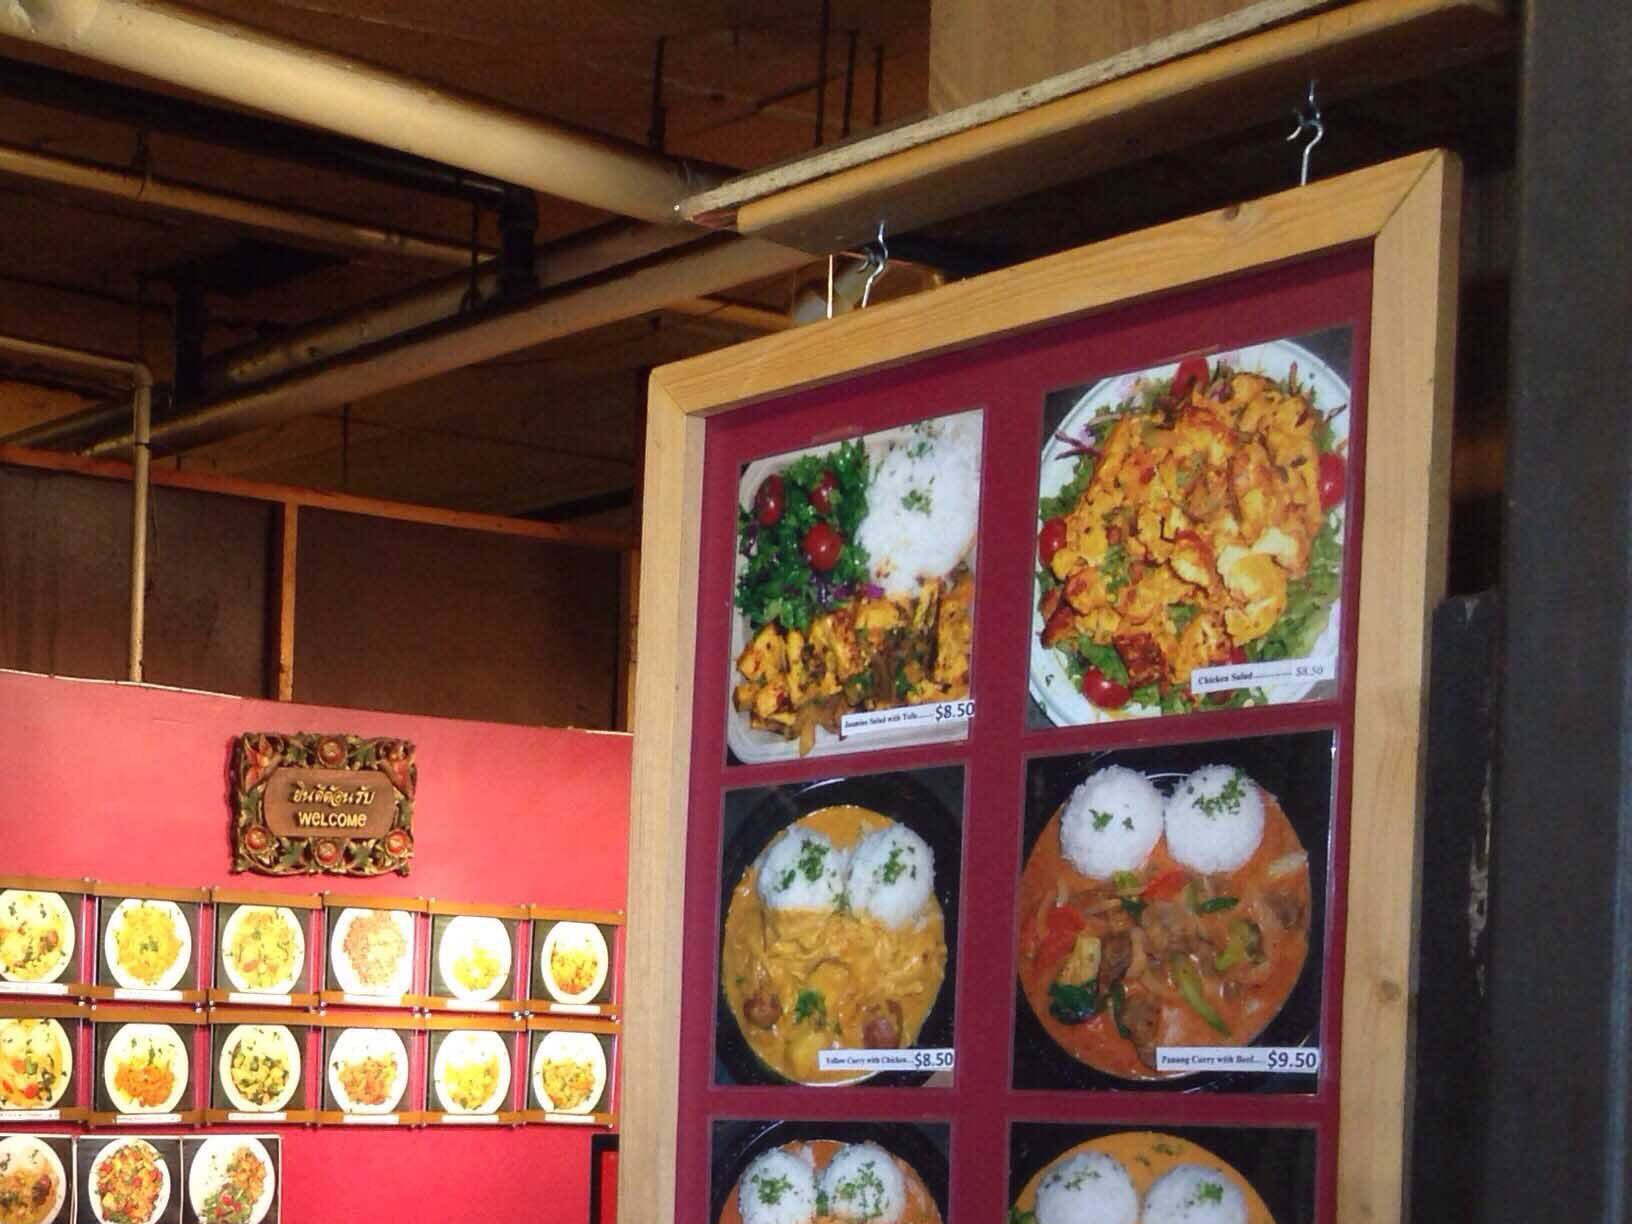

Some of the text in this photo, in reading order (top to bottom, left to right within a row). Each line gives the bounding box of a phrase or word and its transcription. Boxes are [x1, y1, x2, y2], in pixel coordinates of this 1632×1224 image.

[1198, 675, 1229, 685] Chicken
[1231, 672, 1253, 681] Salad
[935, 702, 975, 721] $8.50
[915, 1051, 954, 1068] $8.50
[1161, 1055, 1189, 1065] Panang
[1191, 1055, 1215, 1065] Curry
[1217, 1055, 1233, 1063] with
[1268, 1050, 1317, 1069] $9.50
